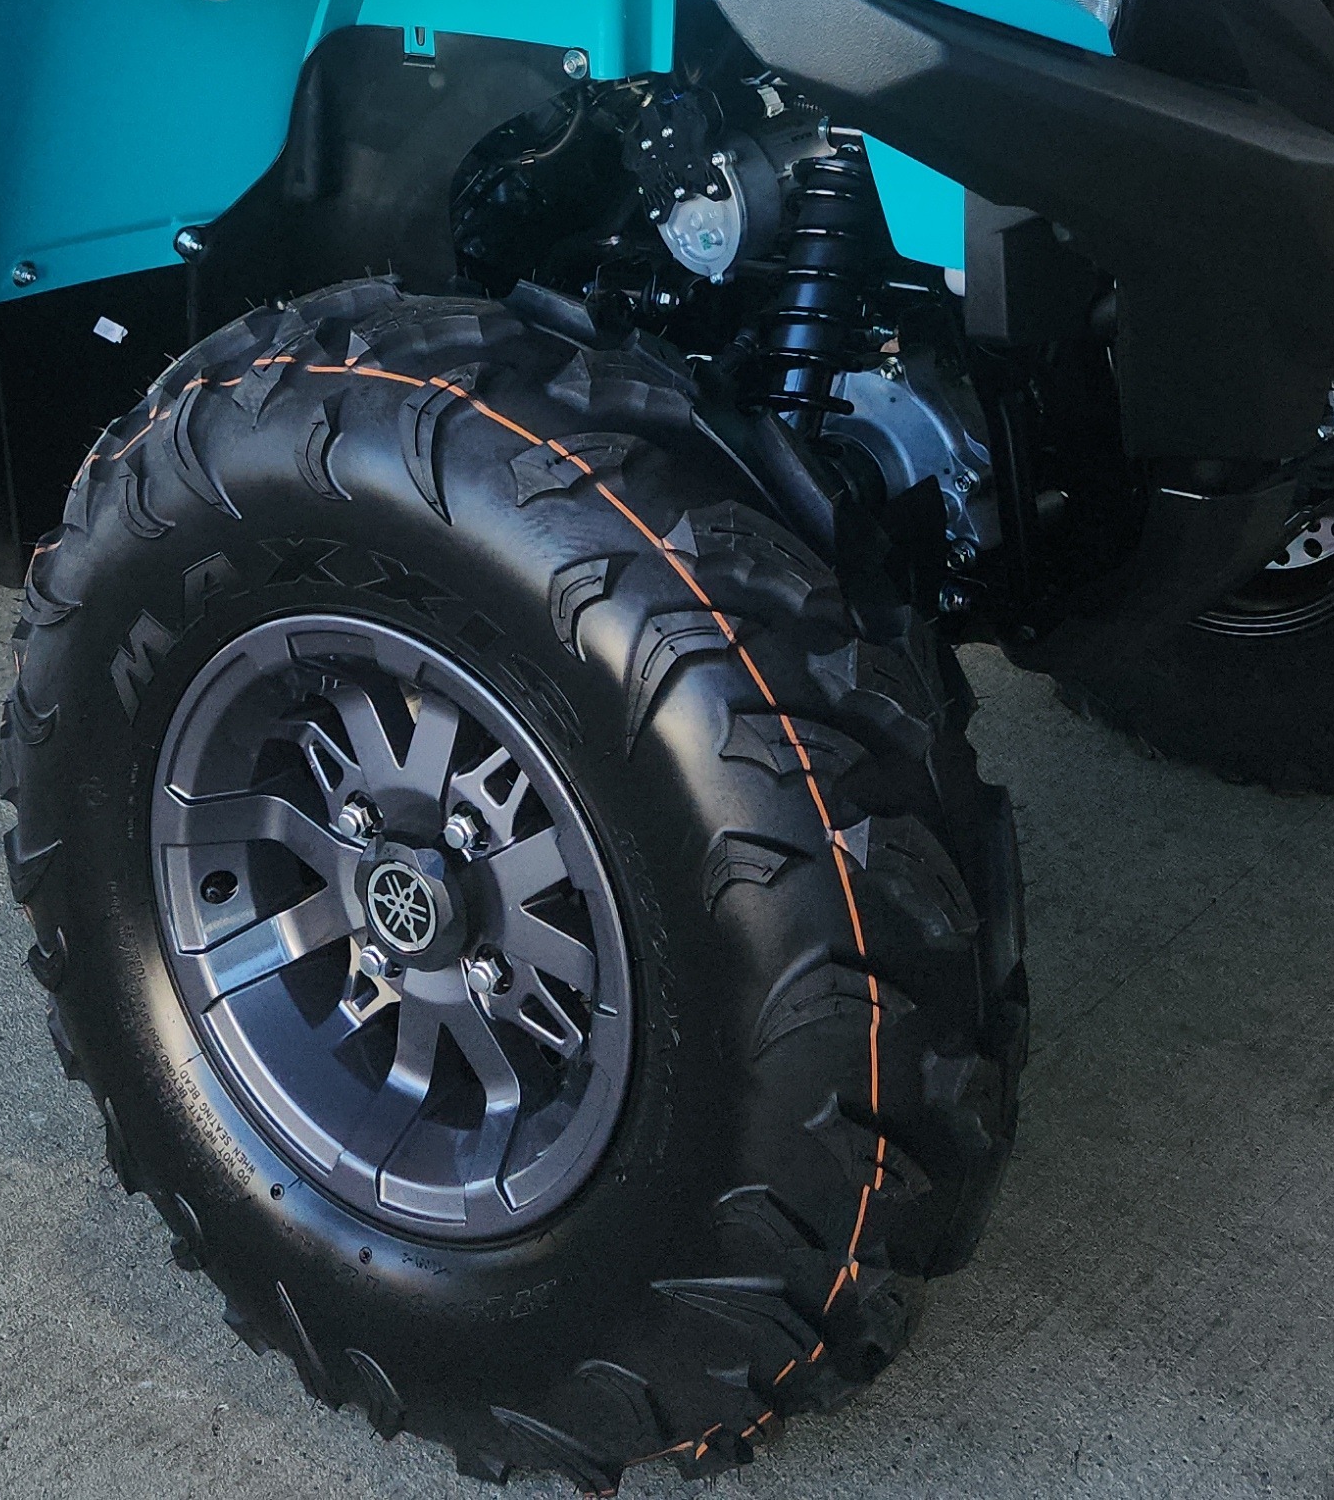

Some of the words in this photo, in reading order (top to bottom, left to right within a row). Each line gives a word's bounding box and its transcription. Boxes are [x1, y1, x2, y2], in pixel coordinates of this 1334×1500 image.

[160, 1054, 189, 1100] BEYOND
[180, 1070, 201, 1100] BEAD
[186, 1101, 219, 1145] INFLATE
[199, 1102, 233, 1147] SEATING
[232, 1147, 257, 1177] WHEN
